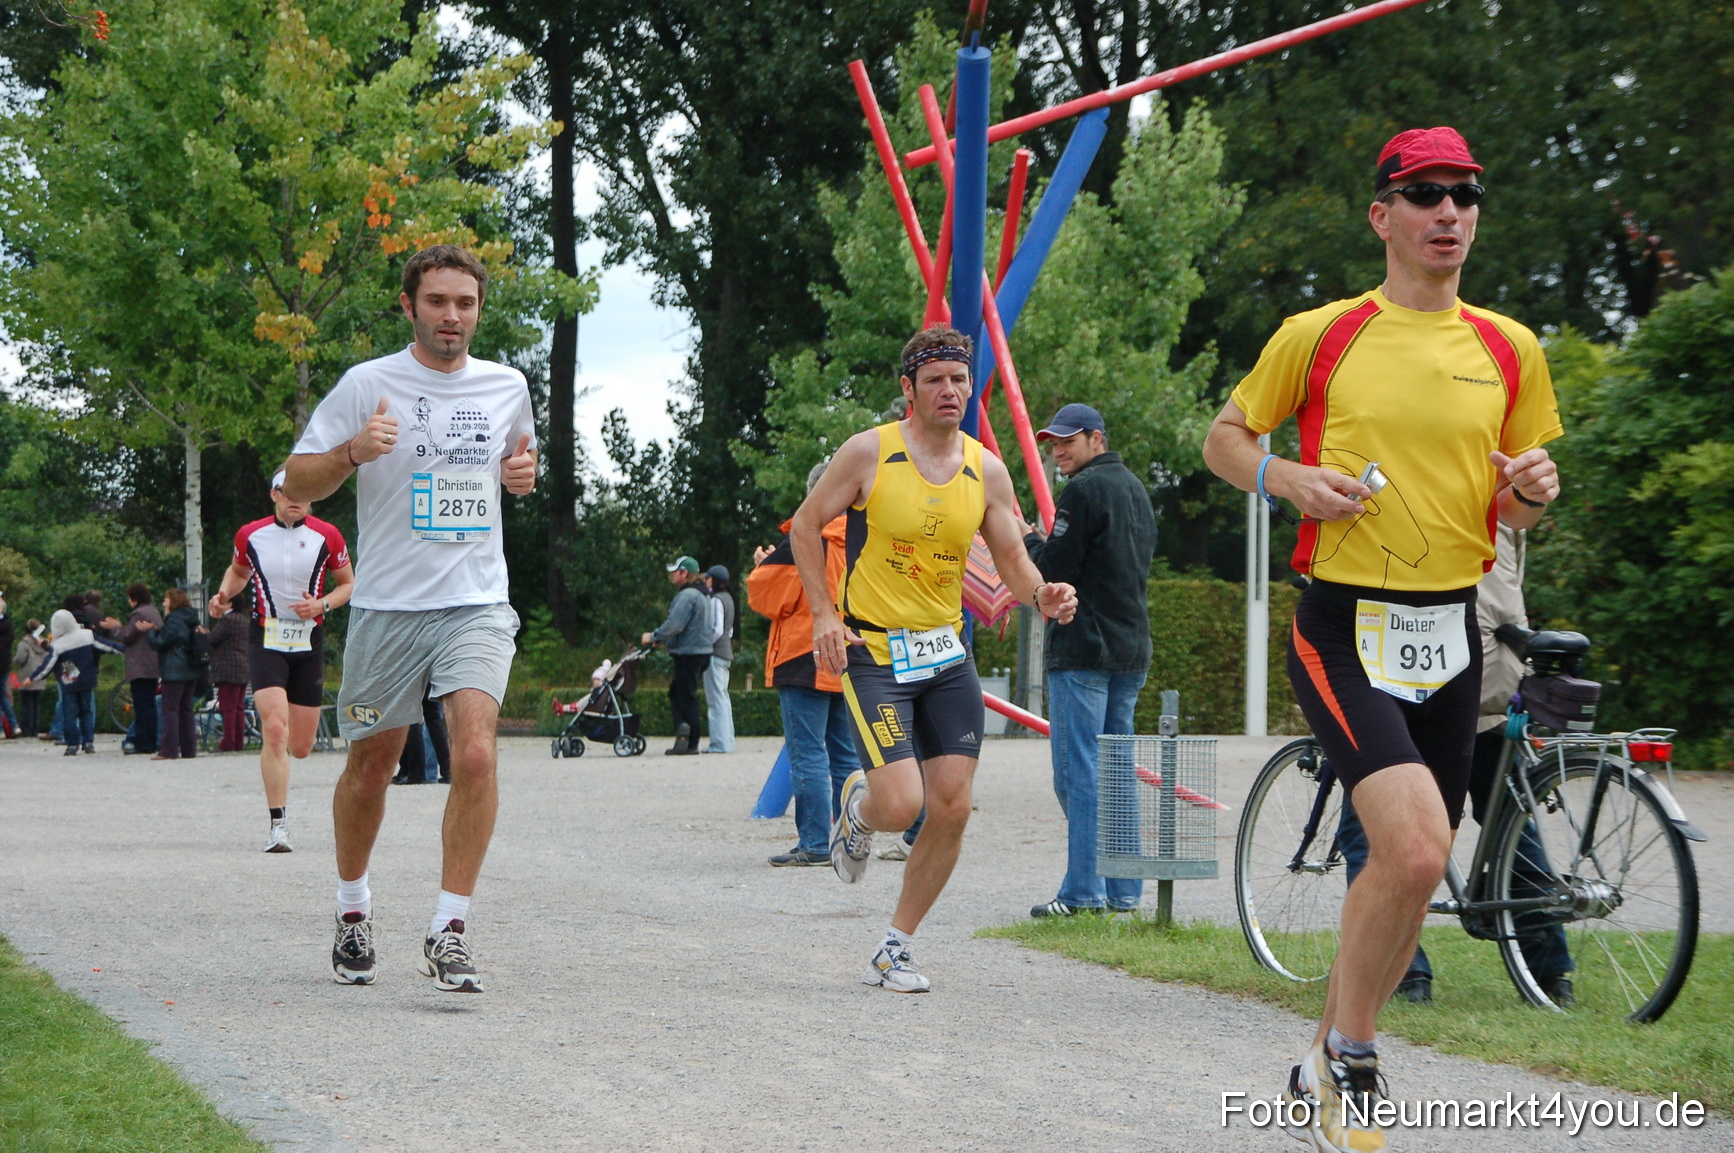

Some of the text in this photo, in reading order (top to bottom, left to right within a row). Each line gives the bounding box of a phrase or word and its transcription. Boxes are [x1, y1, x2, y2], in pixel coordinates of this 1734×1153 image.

[450, 423, 490, 431] 21.09.2008
[416, 445, 490, 457] 9. Neumarkter
[448, 456, 490, 465] Stadtlauf
[438, 478, 483, 491] Christian
[418, 498, 424, 507] A
[438, 499, 487, 517] 2876
[892, 542, 914, 554] Seidl
[1390, 613, 1435, 632] Dieter
[283, 629, 302, 639] 571
[914, 634, 953, 658] 2186
[1361, 638, 1368, 651] A
[1400, 644, 1447, 671] 931
[354, 706, 375, 724] SC
